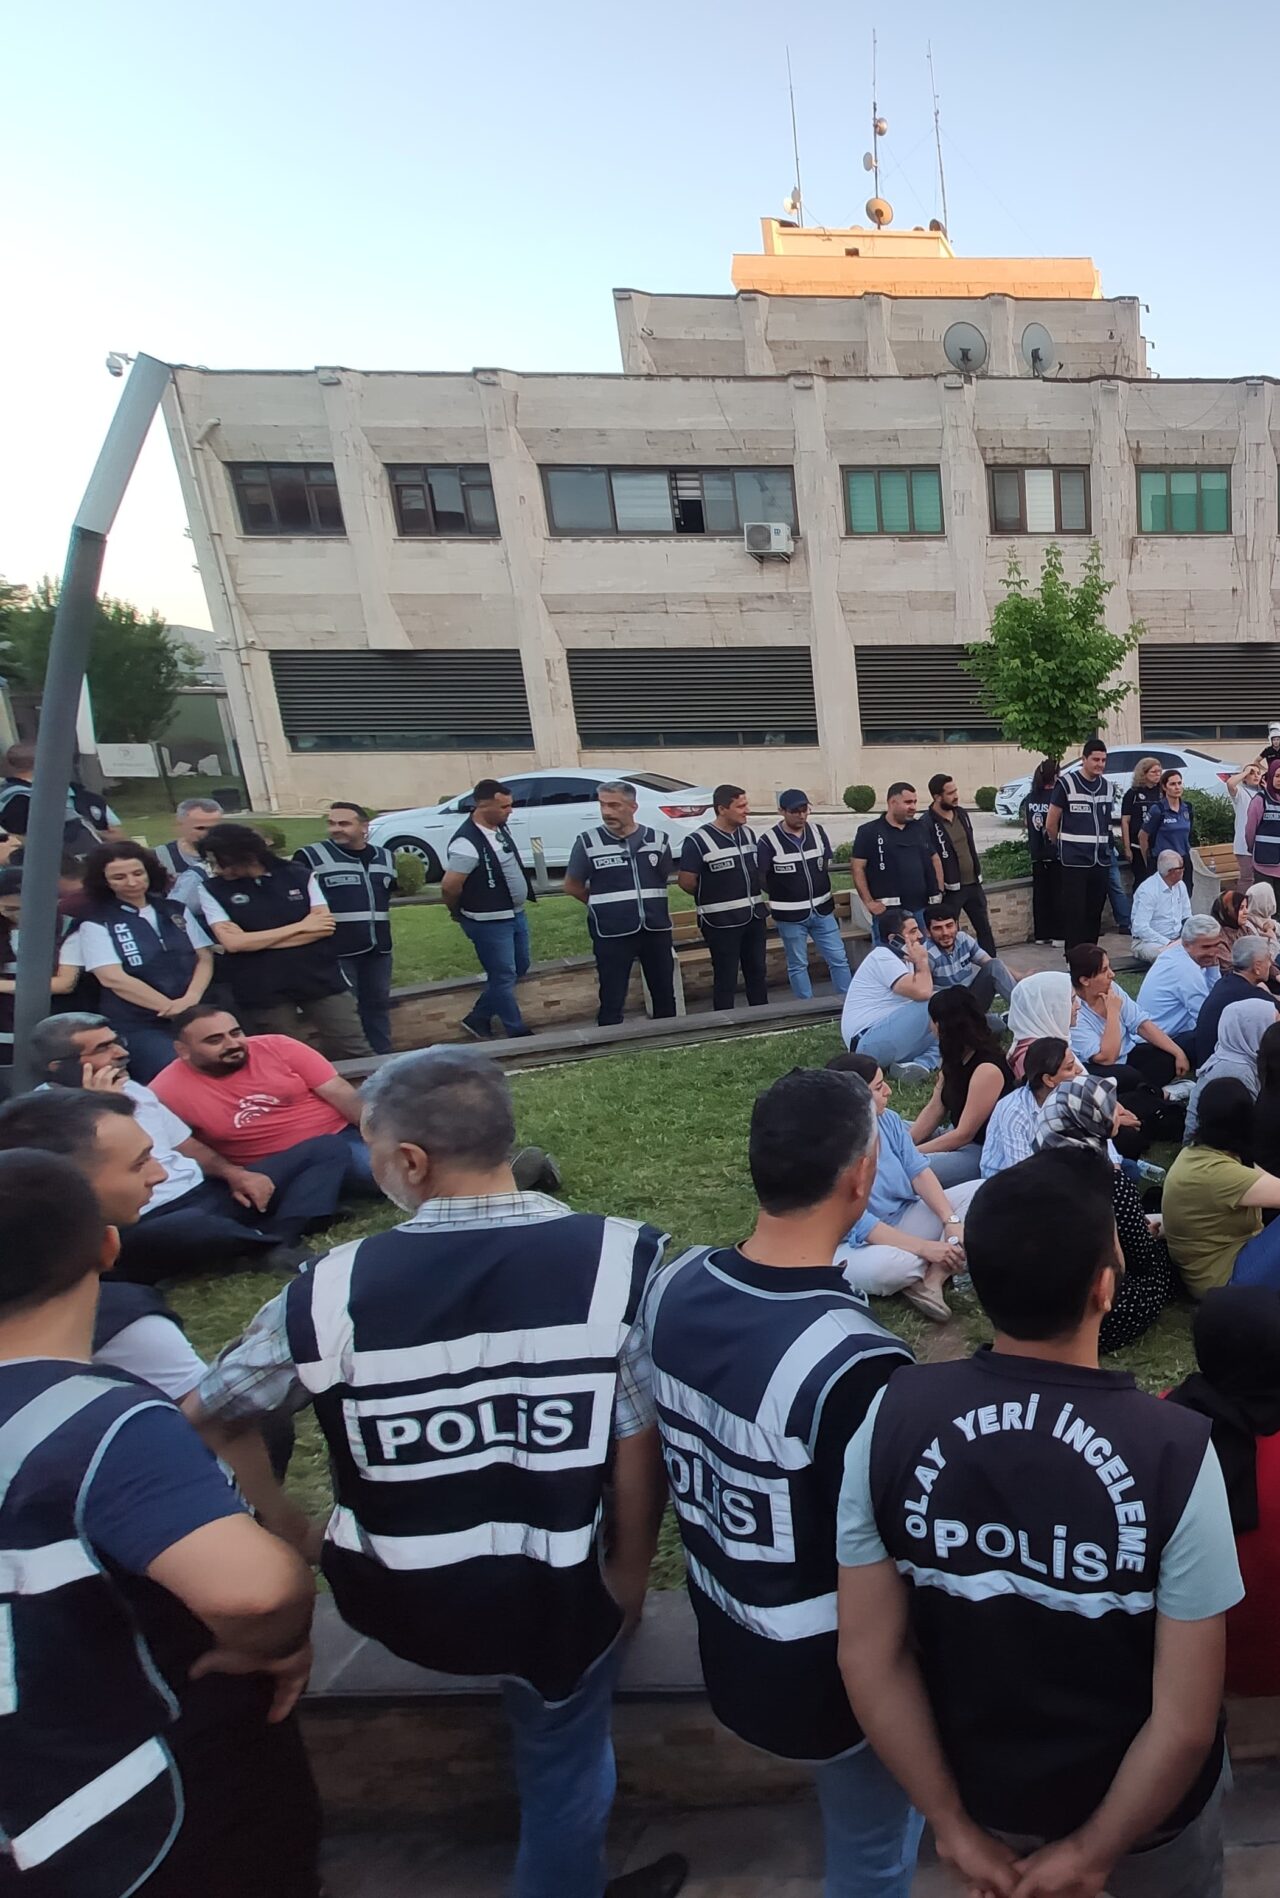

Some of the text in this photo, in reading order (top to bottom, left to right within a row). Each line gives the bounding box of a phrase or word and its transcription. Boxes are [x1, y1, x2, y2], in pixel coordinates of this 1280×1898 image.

[878, 835, 886, 870] OLIS
[665, 1447, 757, 1535] OLİS
[904, 1437, 947, 1539] OLAY
